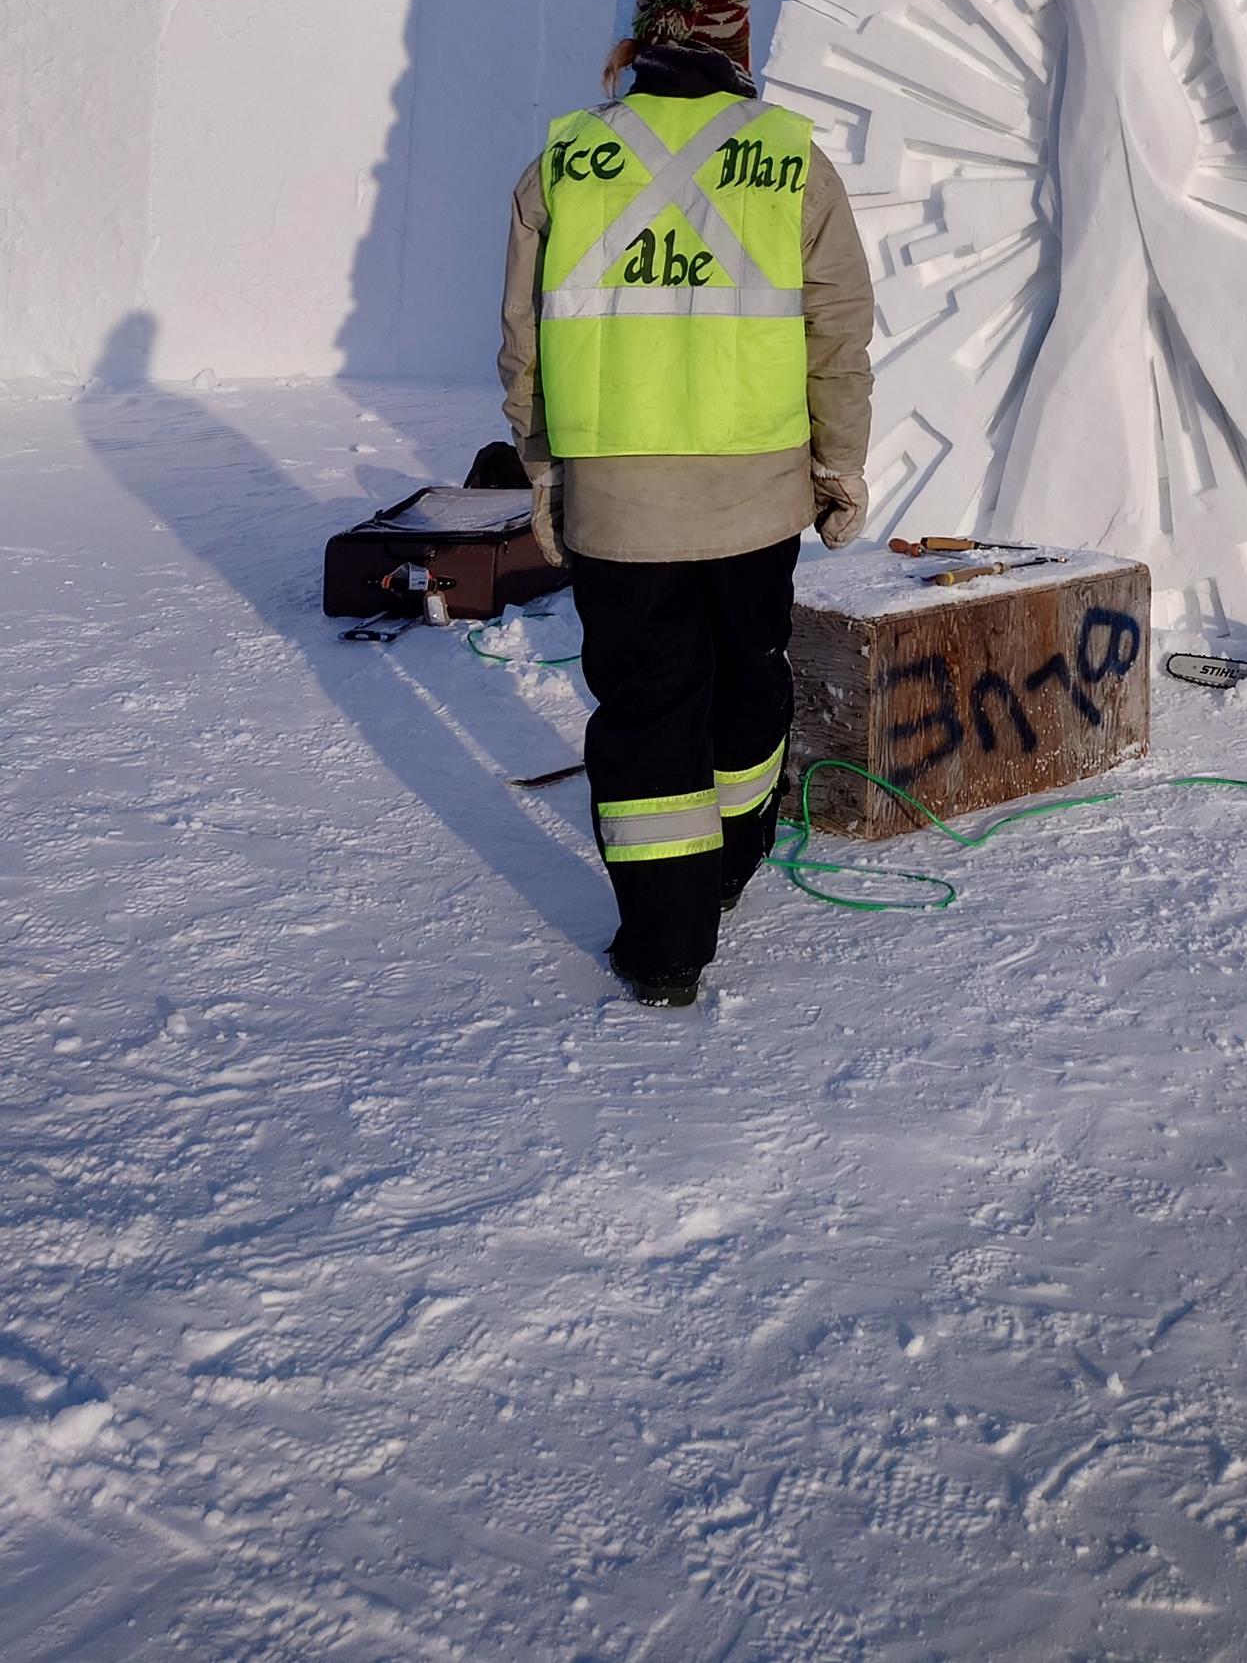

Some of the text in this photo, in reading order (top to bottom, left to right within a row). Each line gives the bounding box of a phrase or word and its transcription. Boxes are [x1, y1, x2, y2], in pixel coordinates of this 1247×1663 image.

[549, 135, 805, 193] Ice Man
[1200, 665, 1237, 678] STIHL
